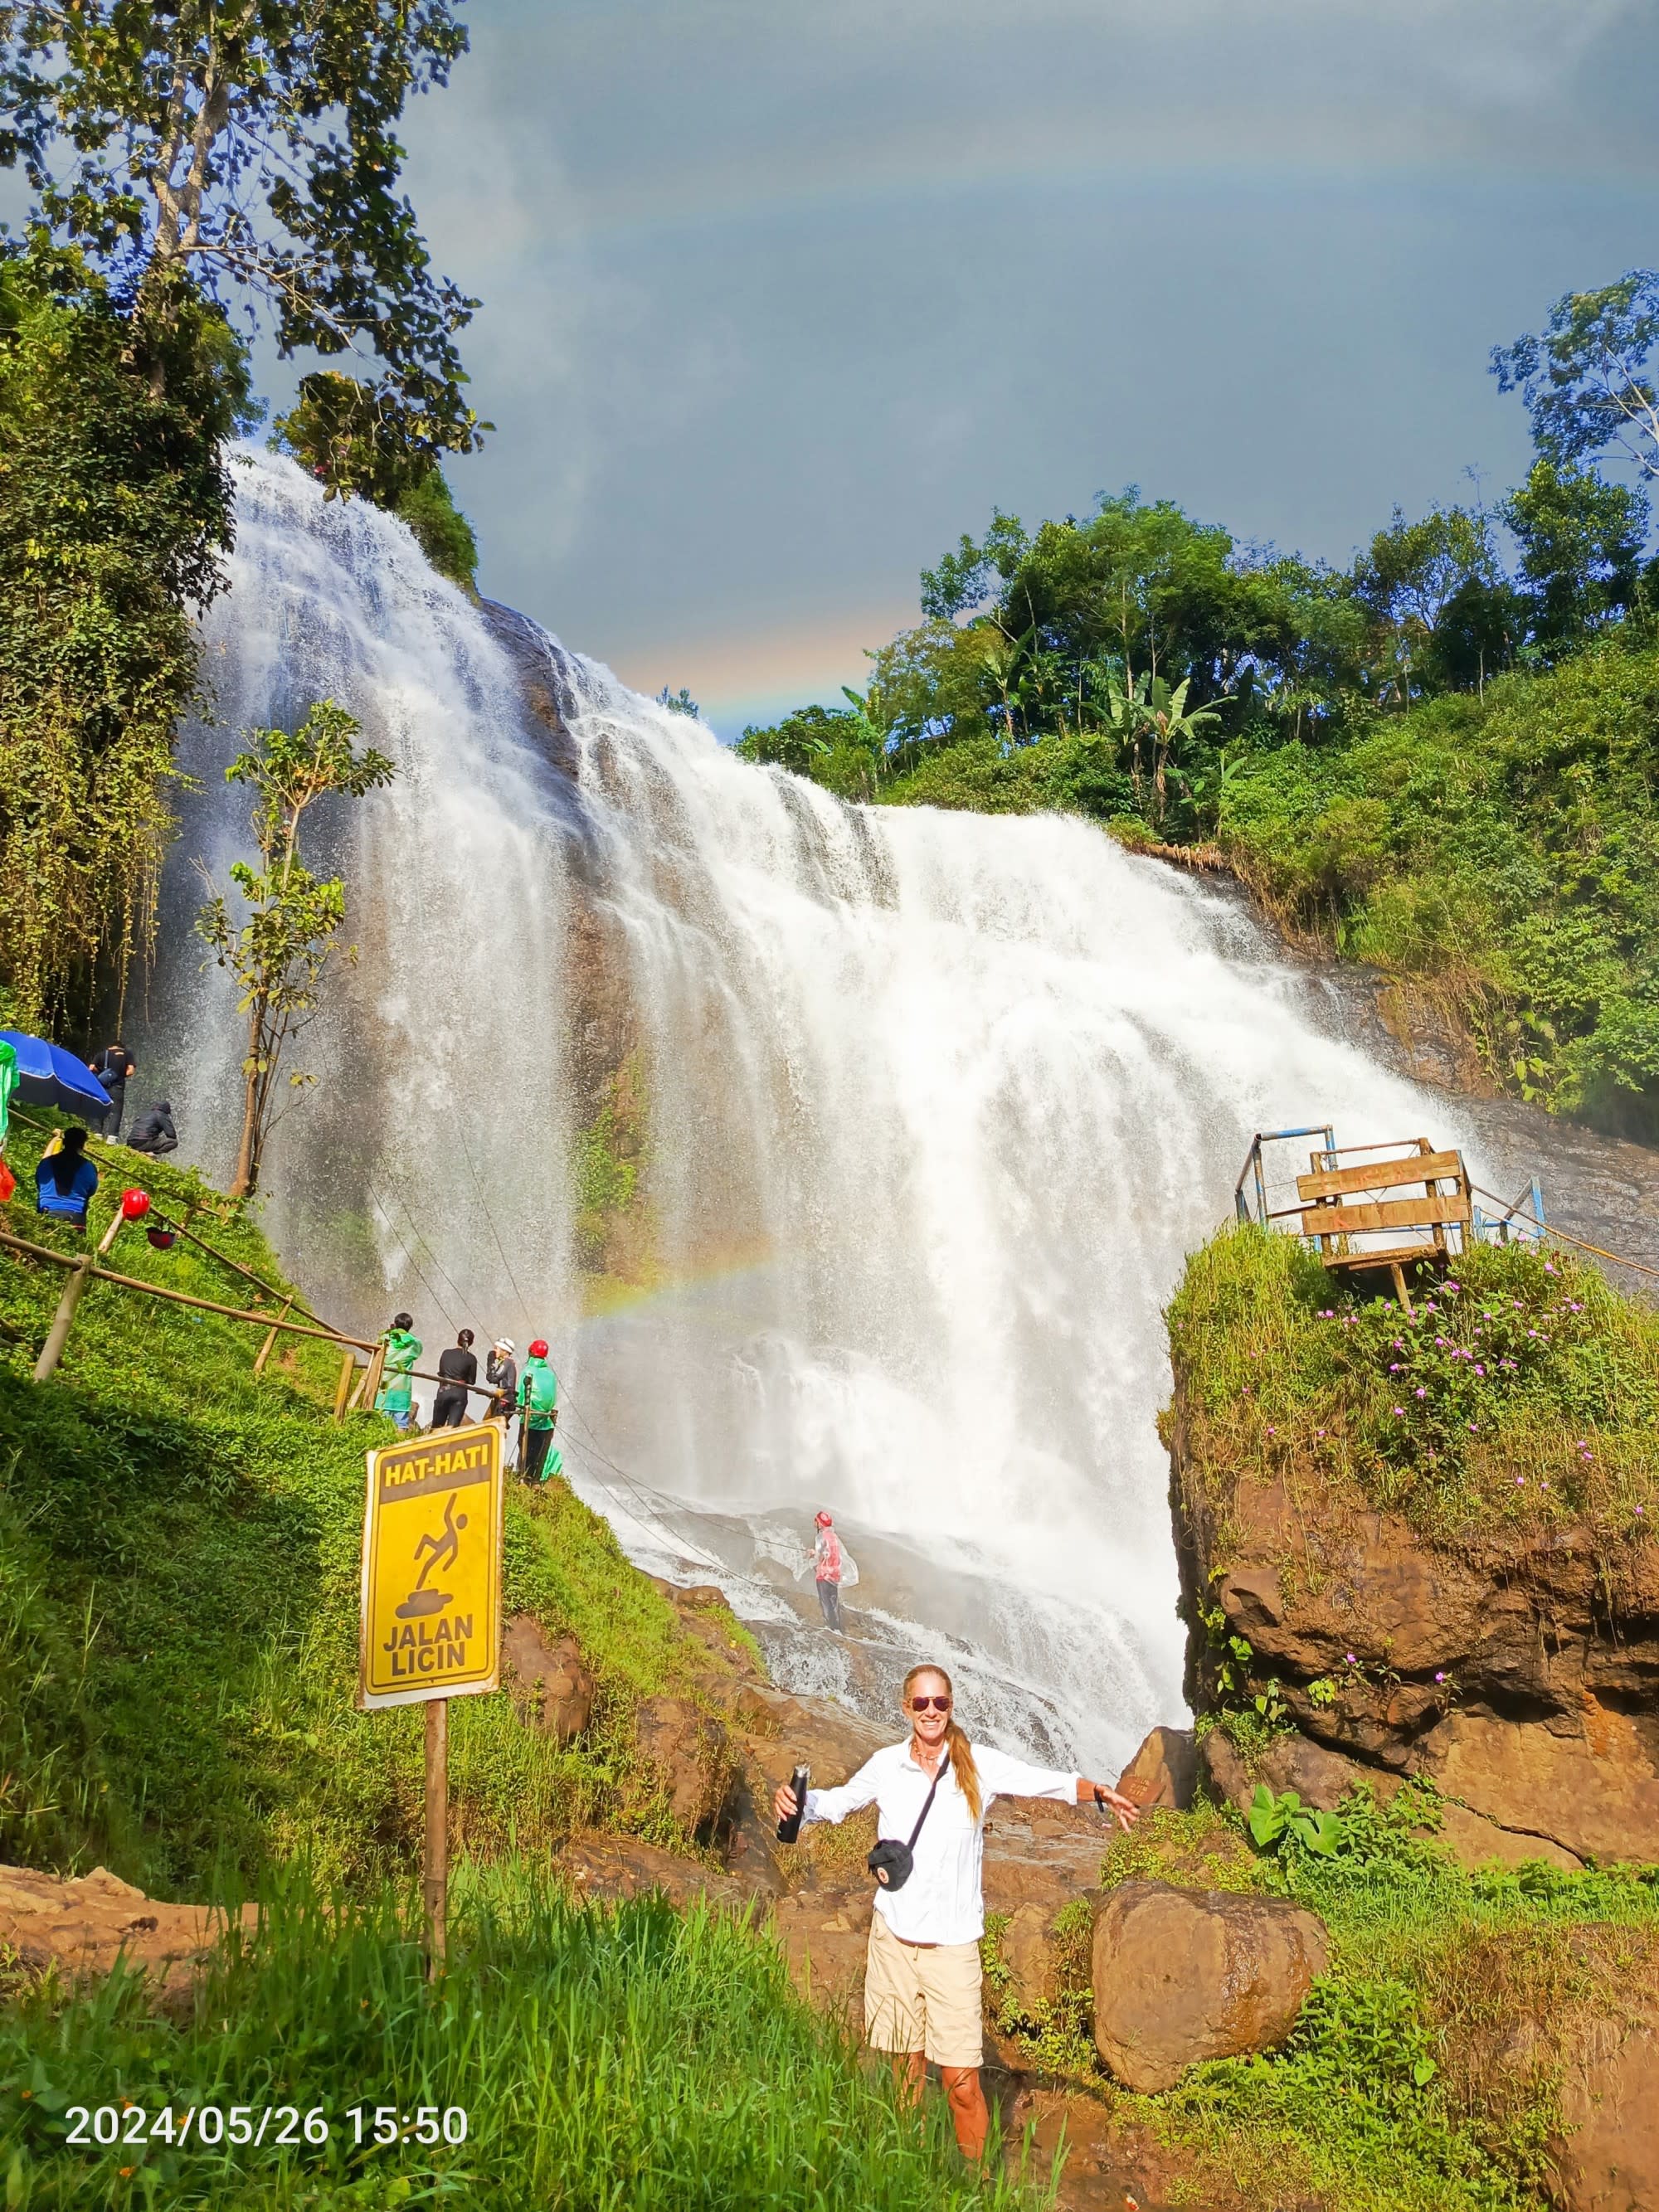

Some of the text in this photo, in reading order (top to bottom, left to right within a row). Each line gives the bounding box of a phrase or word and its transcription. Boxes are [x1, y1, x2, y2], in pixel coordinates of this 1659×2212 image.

[385, 1444, 488, 1487] HAT-HATI
[383, 1614, 473, 1651] JALAN
[392, 1641, 465, 1676] LICIN
